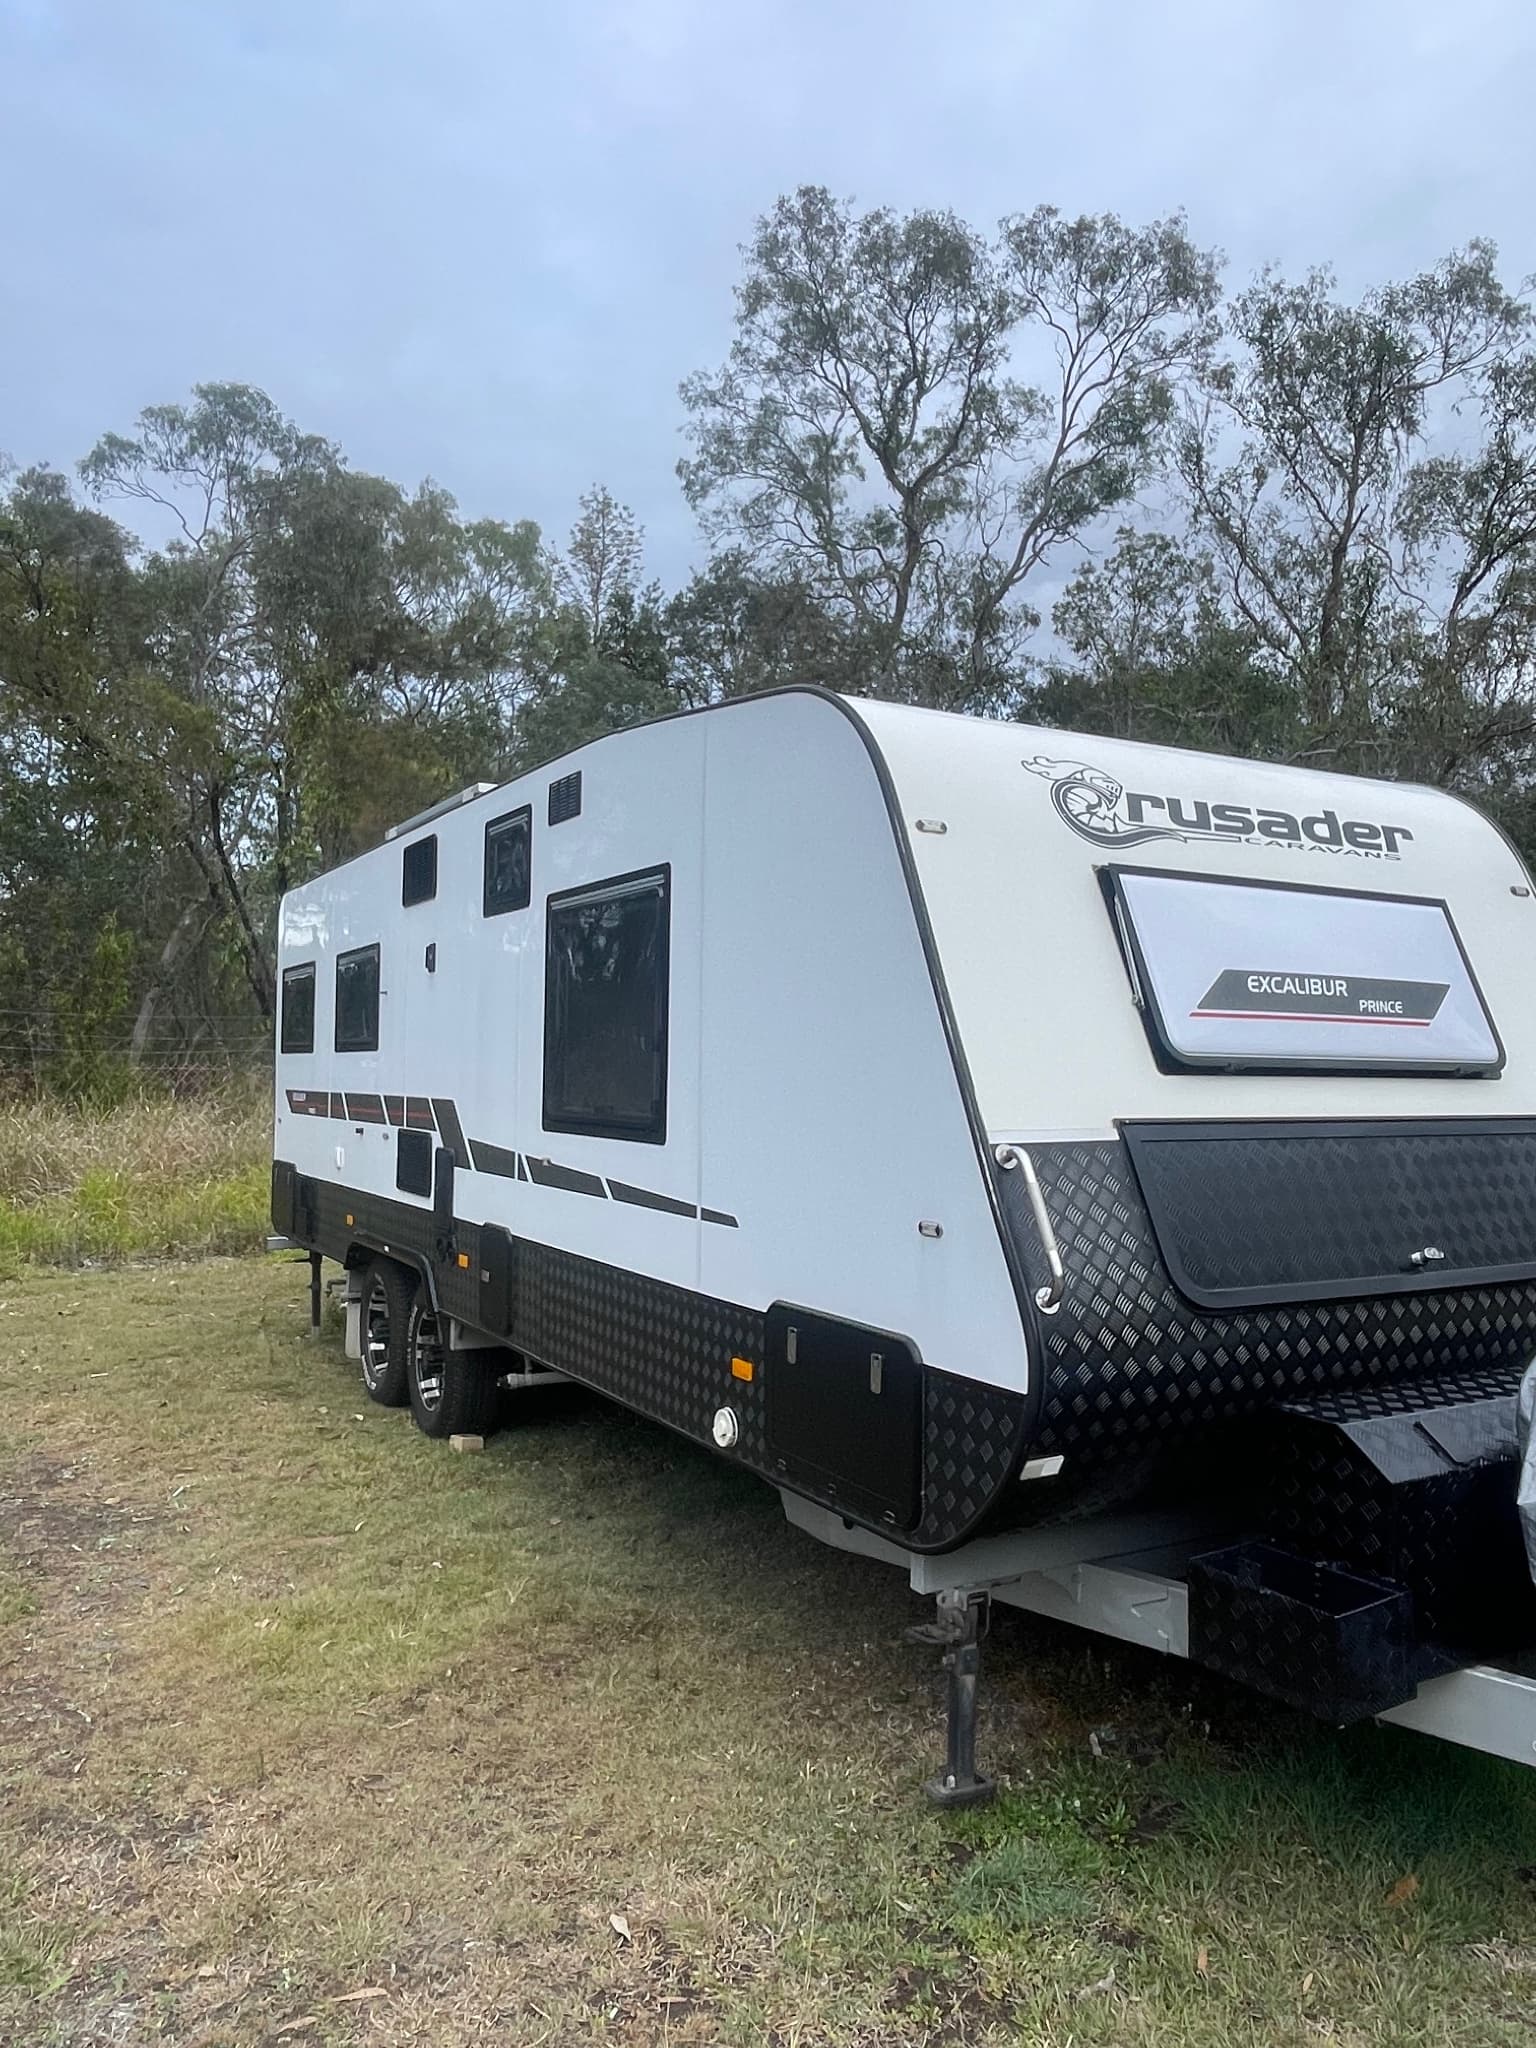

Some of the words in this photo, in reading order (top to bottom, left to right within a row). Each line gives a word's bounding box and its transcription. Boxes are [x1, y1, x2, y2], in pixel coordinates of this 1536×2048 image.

[1245, 836, 1401, 861] CARAVANS
[1247, 975, 1348, 997] EXCALIBUR
[1359, 999, 1404, 1014] PRINCE
